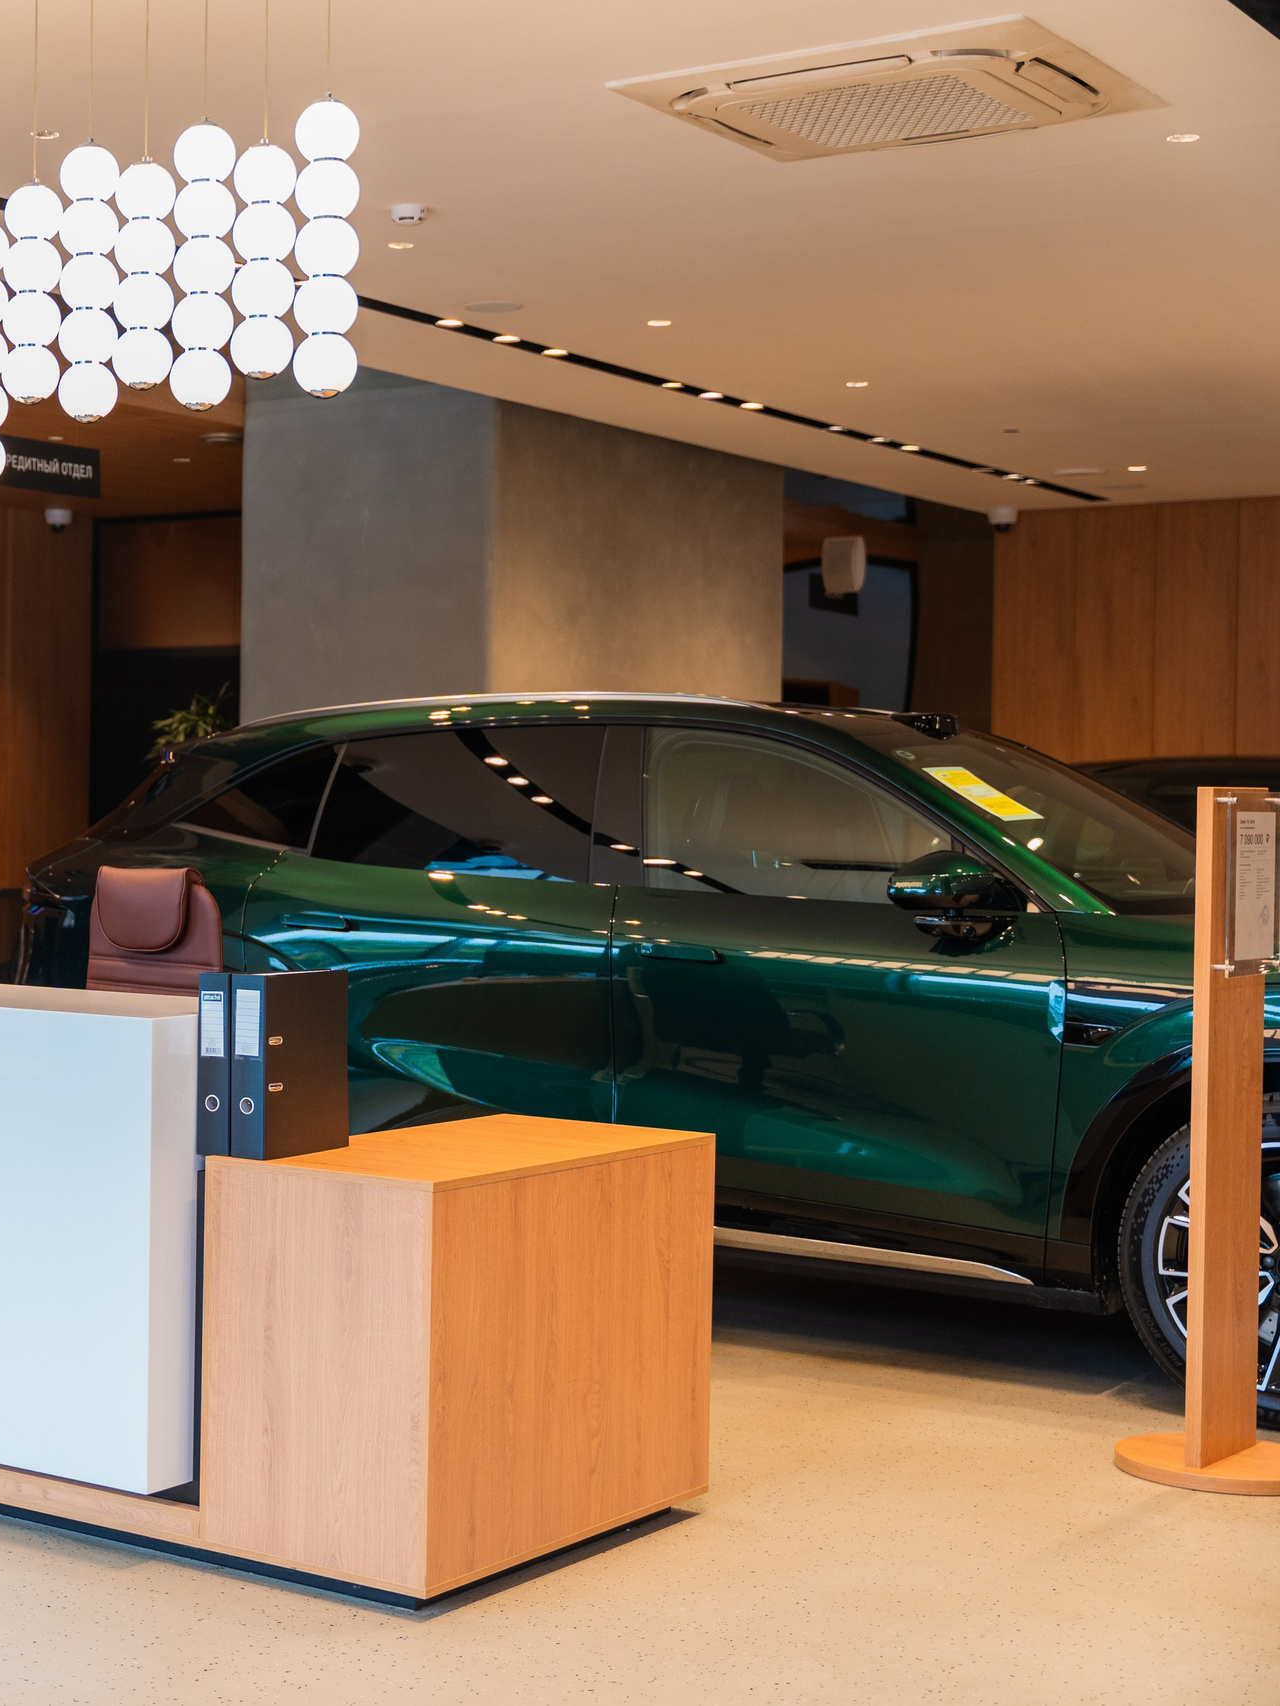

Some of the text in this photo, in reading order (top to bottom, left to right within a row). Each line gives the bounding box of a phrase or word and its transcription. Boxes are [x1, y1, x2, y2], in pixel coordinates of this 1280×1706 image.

[6, 453, 93, 480] РЕДИТНЫЙ ОТДЕЛ
[1244, 834, 1253, 845] 090
[1254, 834, 1263, 845] 000
[1159, 1342, 1182, 1367] PILOT
